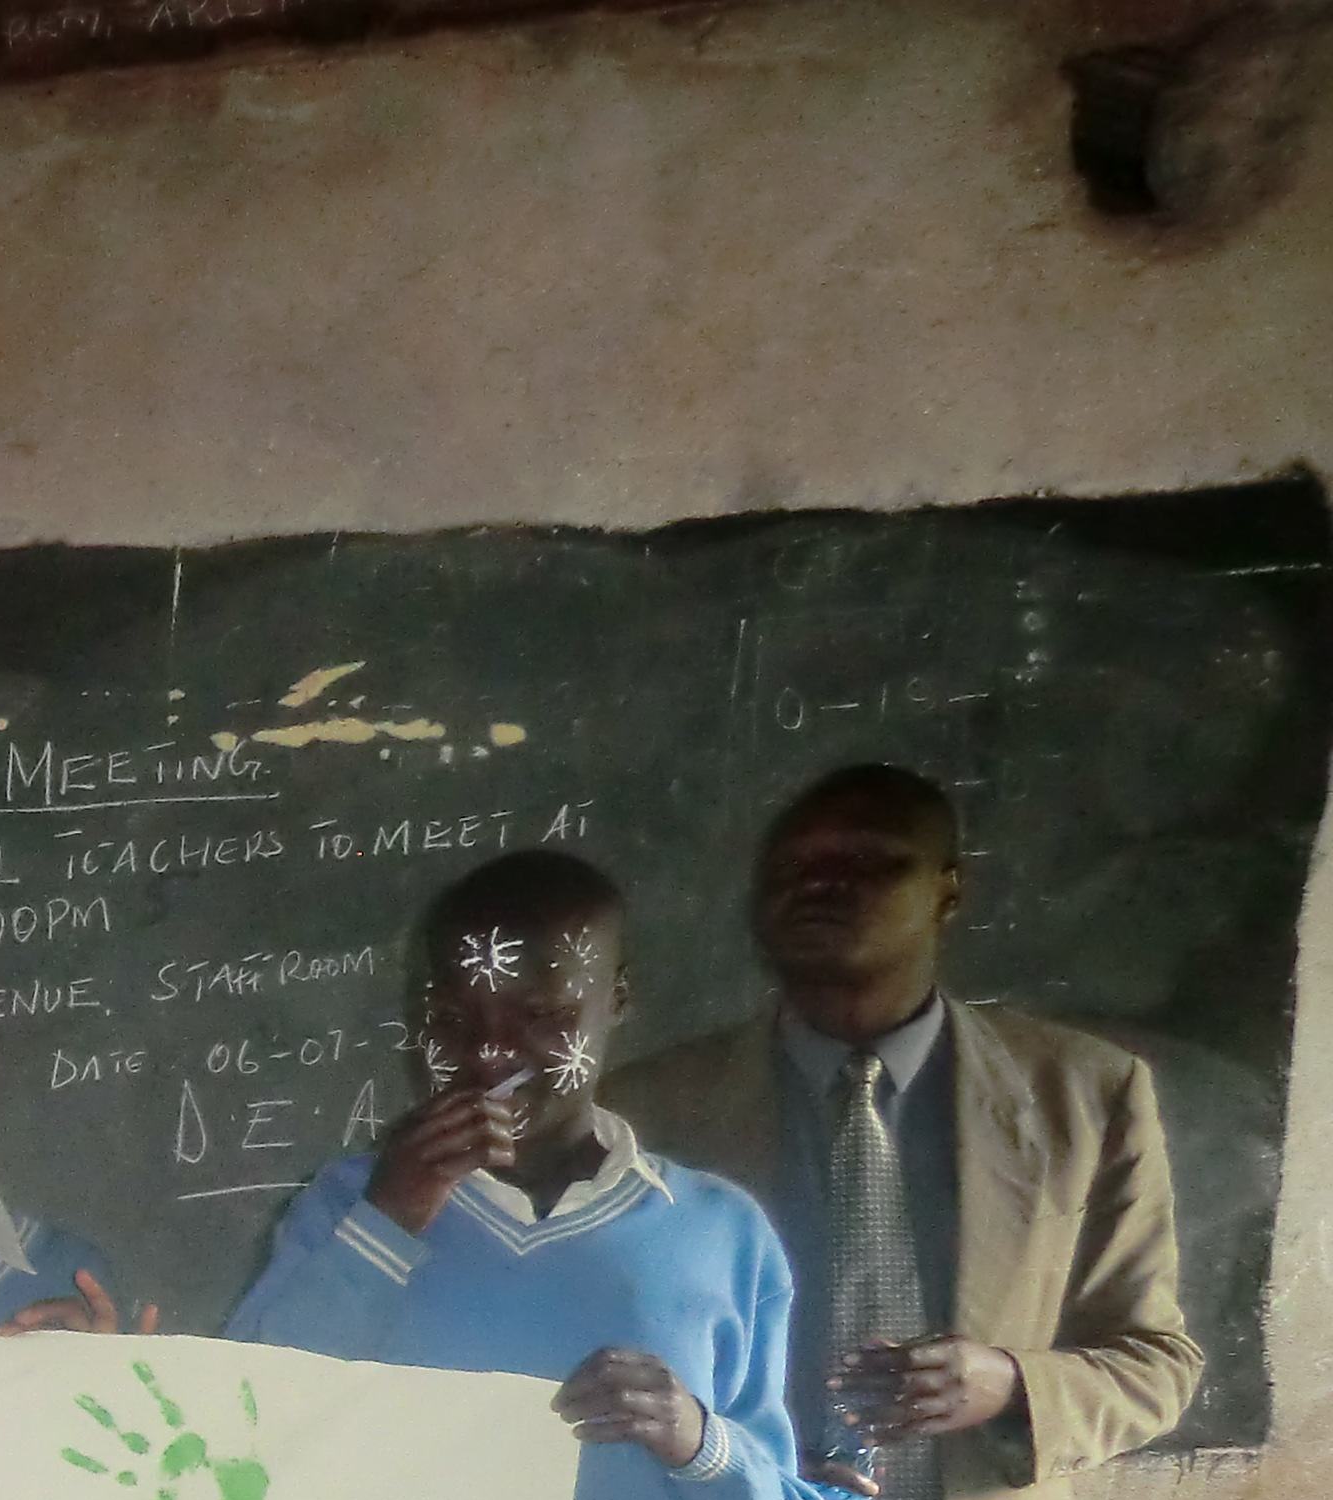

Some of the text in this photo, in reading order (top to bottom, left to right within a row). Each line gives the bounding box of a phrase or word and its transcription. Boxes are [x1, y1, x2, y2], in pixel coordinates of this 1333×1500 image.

[53, 828, 286, 882] TEACHERS
[373, 809, 515, 857] MEET
[541, 800, 594, 842] AT
[51, 1048, 147, 1090] DATE
